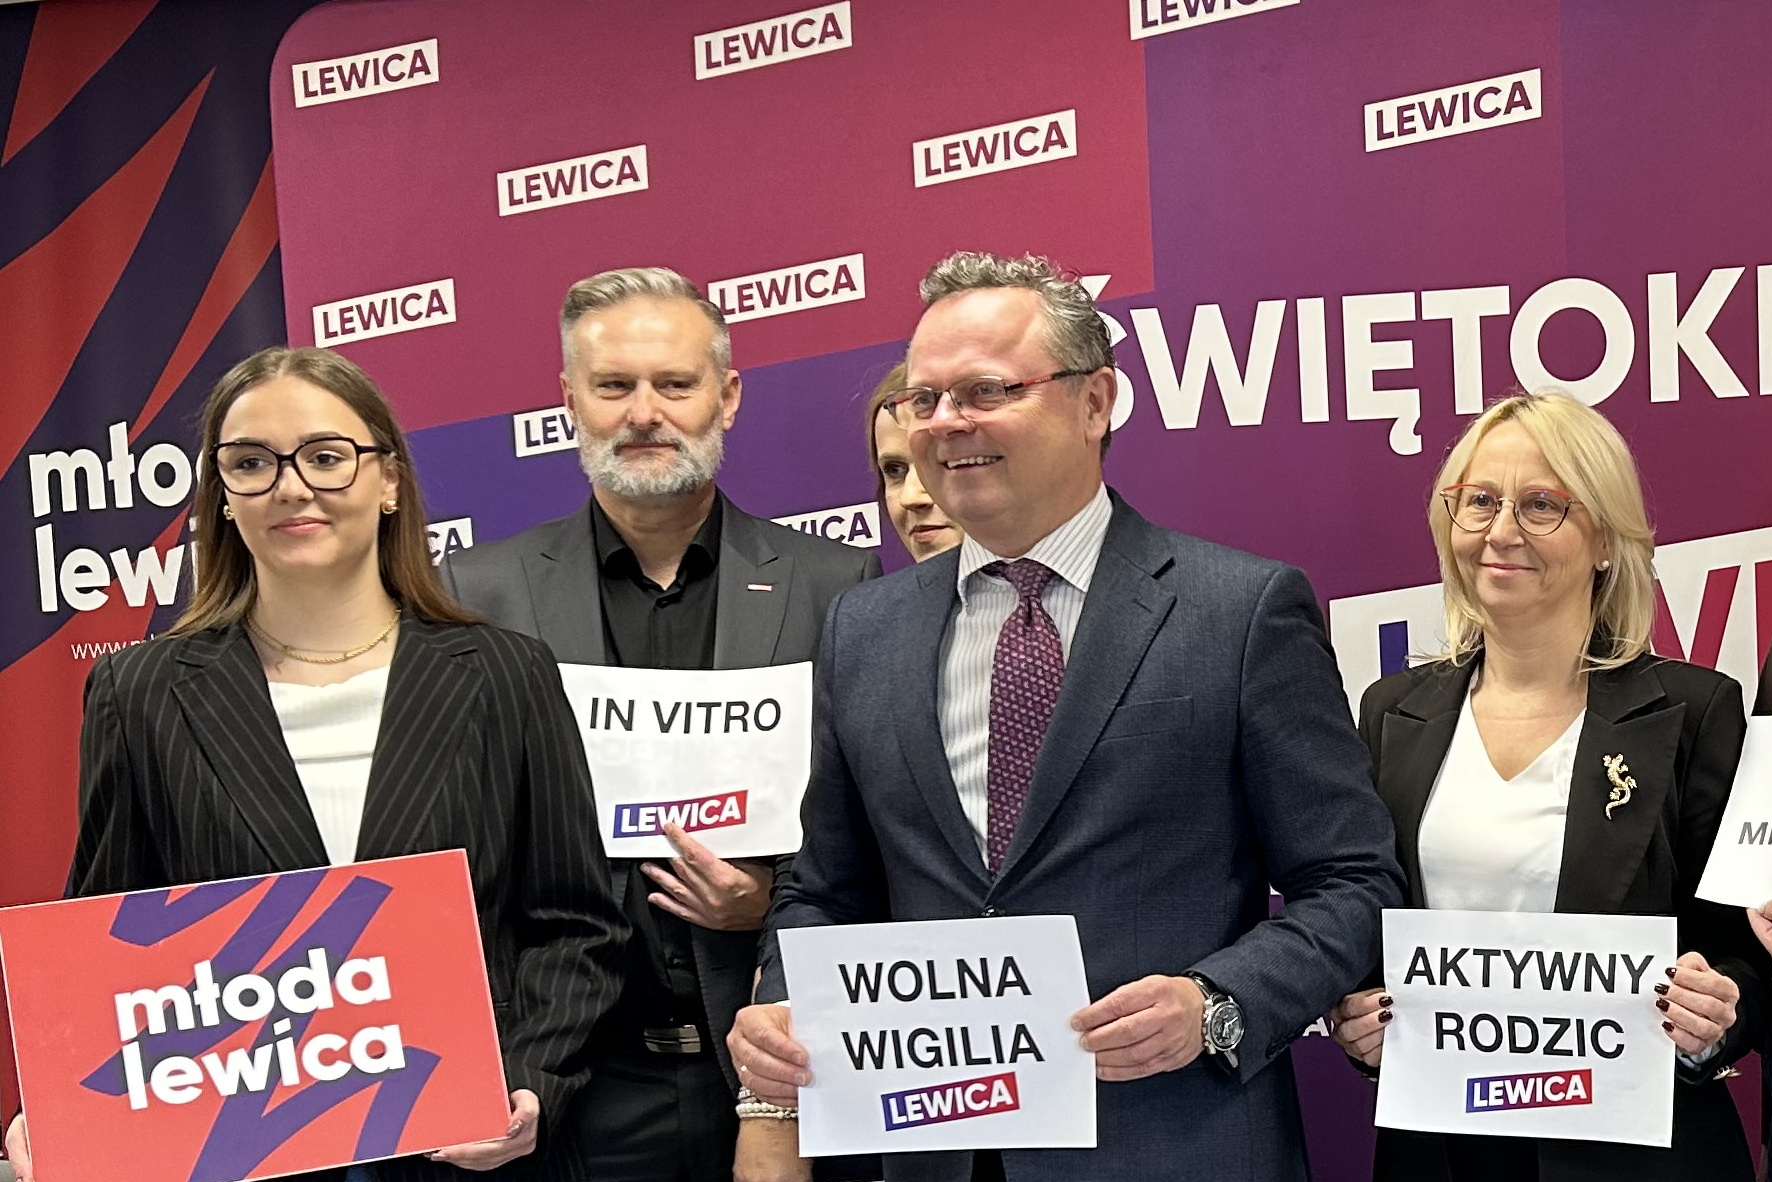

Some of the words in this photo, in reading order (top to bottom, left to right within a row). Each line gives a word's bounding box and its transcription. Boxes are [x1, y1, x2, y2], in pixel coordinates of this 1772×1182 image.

[705, 12, 843, 69] LEWICA
[302, 49, 431, 98] LEWICA
[1376, 80, 1533, 141] LEWICA
[924, 120, 1069, 178] LEWICA
[507, 155, 640, 206] LEWICA
[323, 289, 448, 339] LEWICA
[719, 264, 857, 316] LEWICA
[29, 421, 205, 517] mło
[590, 697, 635, 731] IN
[652, 698, 781, 734] VITRO
[621, 796, 741, 832] LEWICA
[114, 947, 391, 1041] młoda
[838, 956, 1032, 1003] WOLNA
[1403, 946, 1654, 994] AKTYWNY
[841, 1023, 1045, 1070] WIGILIA
[1435, 1012, 1625, 1059] RODZIC
[122, 1018, 405, 1110] lewica
[888, 1079, 1013, 1124] LEWICA
[1473, 1074, 1587, 1108] LEWICA
